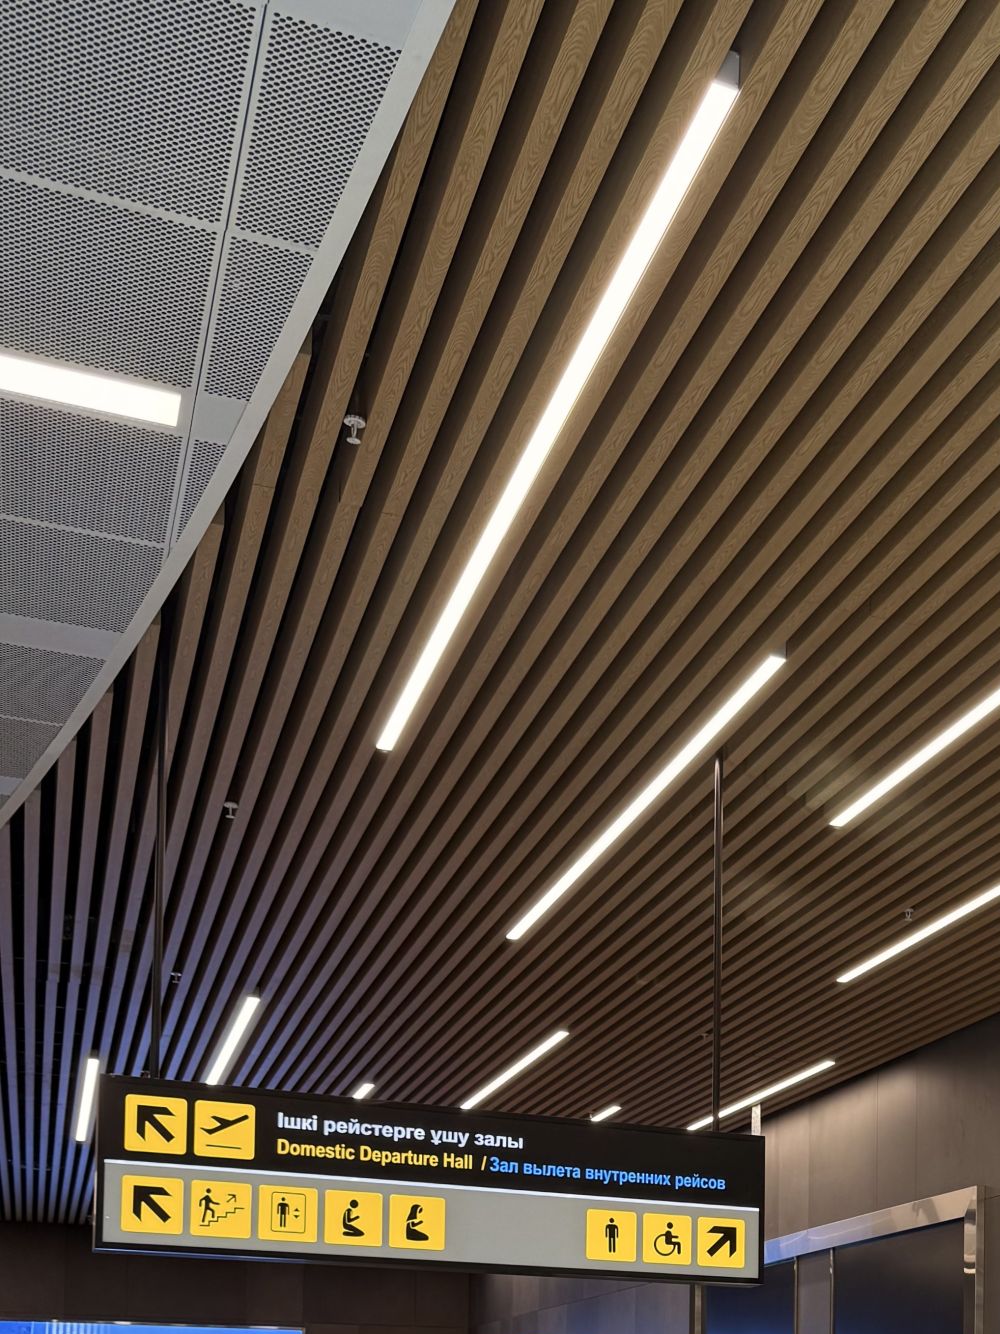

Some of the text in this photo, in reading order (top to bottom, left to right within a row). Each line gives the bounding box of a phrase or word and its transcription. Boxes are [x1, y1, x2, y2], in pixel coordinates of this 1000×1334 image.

[277, 1112, 523, 1149] Ішкі рейстерге ұшу залы
[276, 1138, 355, 1160] Domestic
[360, 1146, 438, 1166] Departure
[443, 1152, 473, 1170] Hall
[489, 1156, 726, 1190] Зал вылета внутренних рейсов
